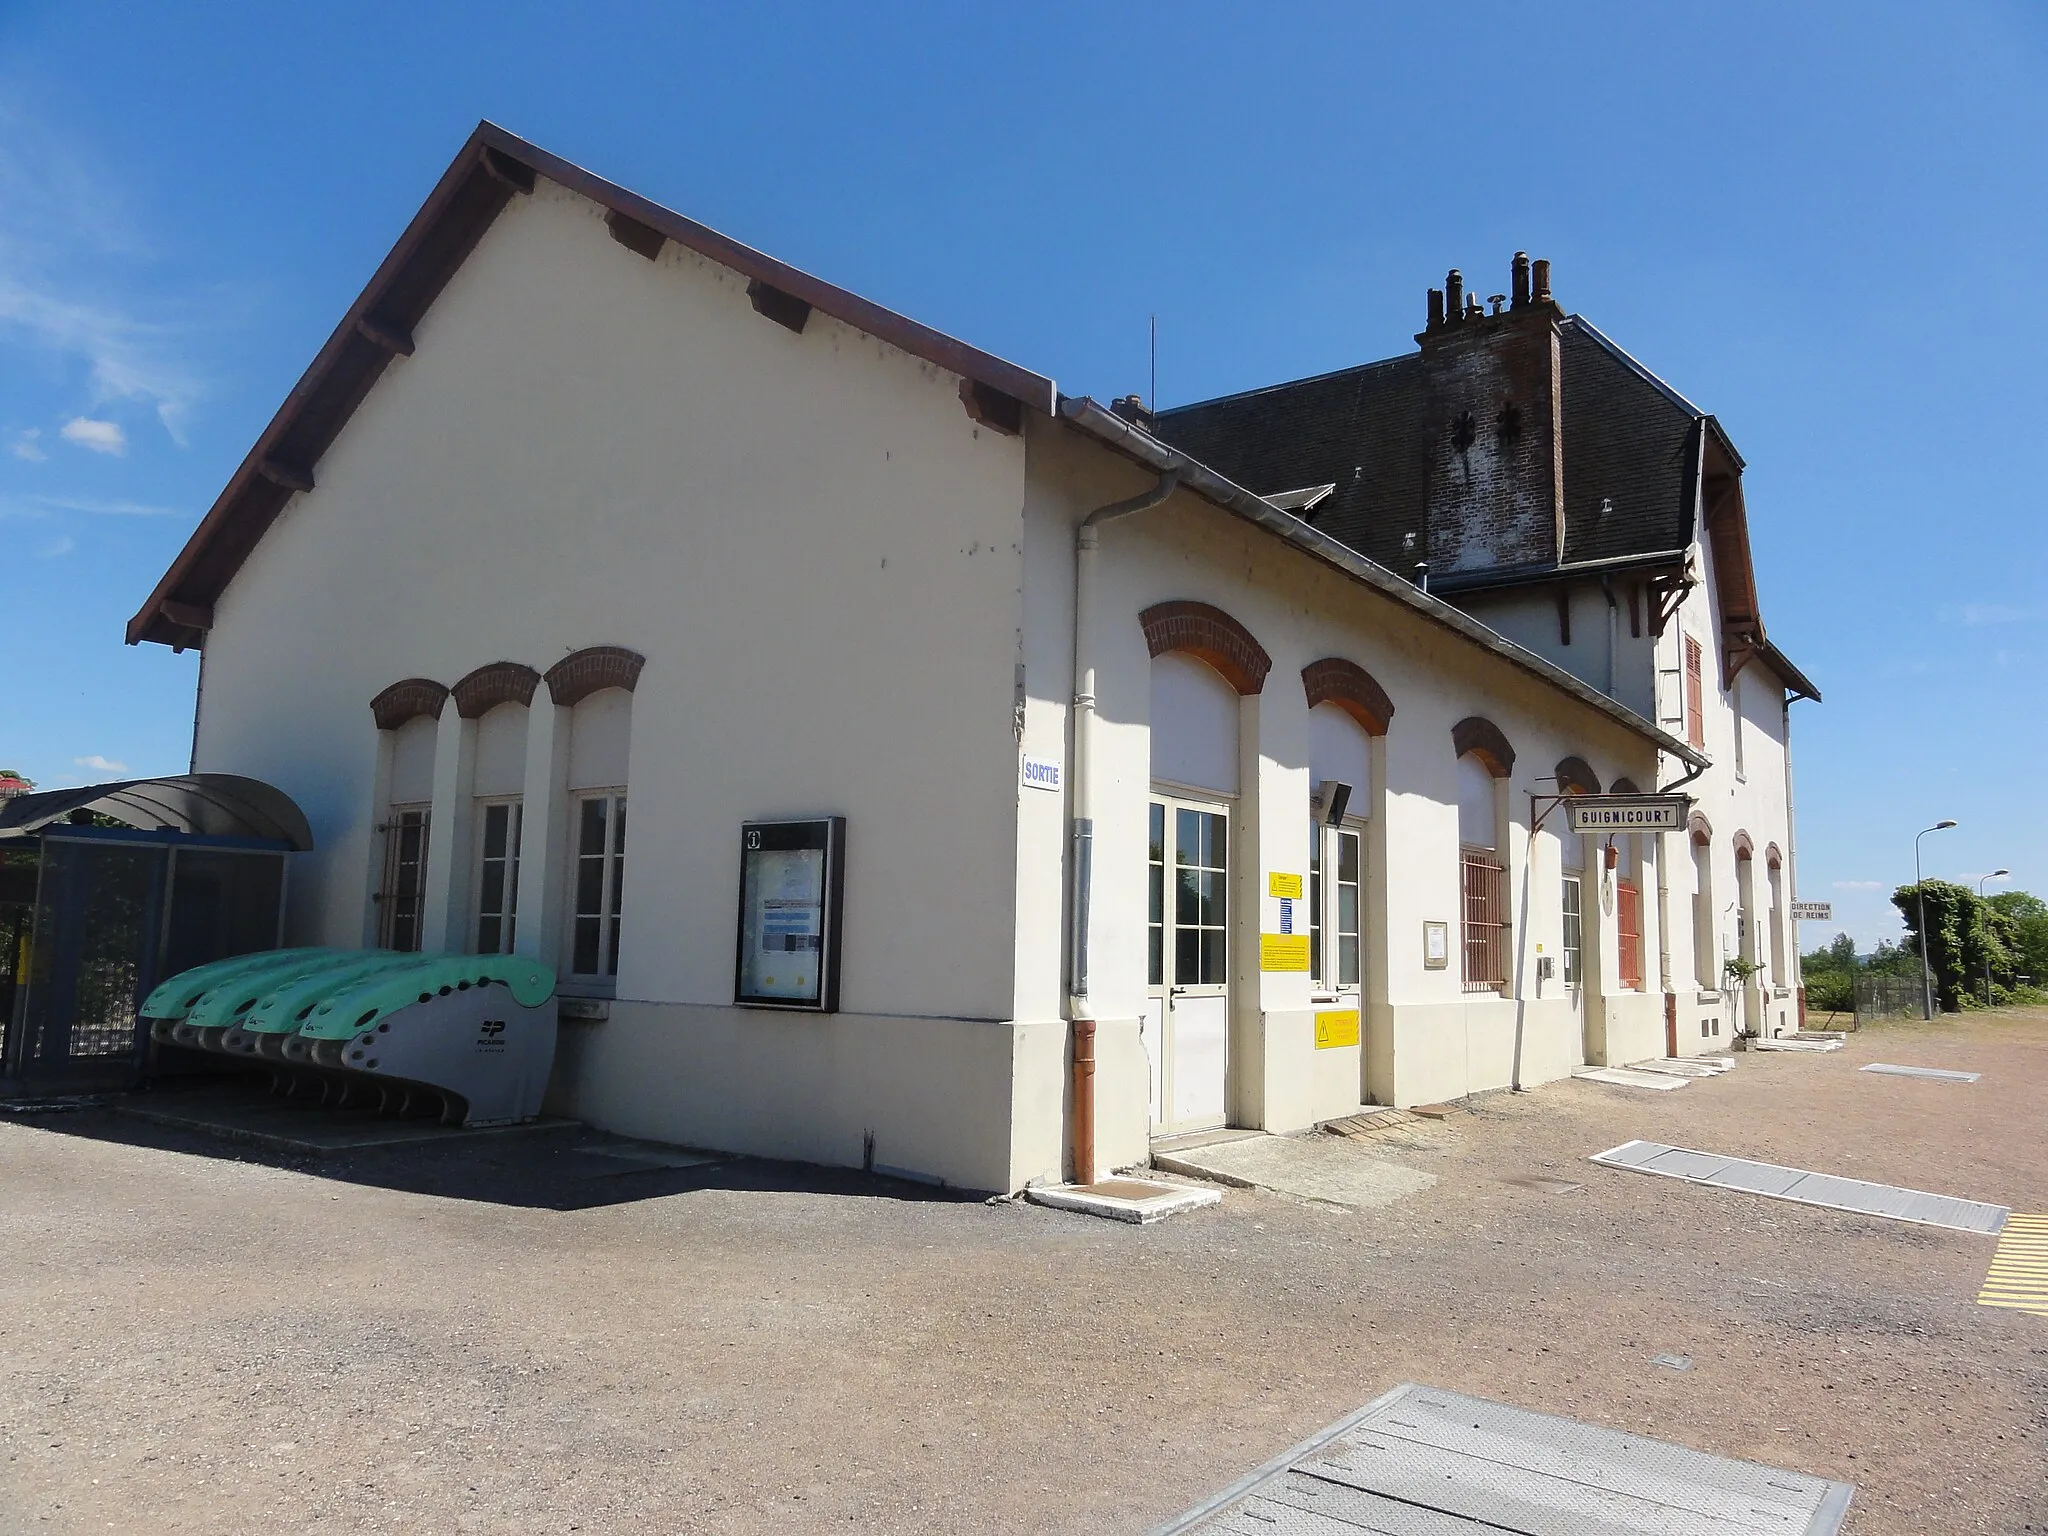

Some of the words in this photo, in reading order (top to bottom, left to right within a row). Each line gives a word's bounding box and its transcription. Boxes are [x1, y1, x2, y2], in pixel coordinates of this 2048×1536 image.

[1025, 761, 1059, 785] SORTIE
[1581, 810, 1670, 823] GUIGNICOURT
[1791, 903, 1830, 911] DIRECTION
[1793, 911, 1802, 919] DE
